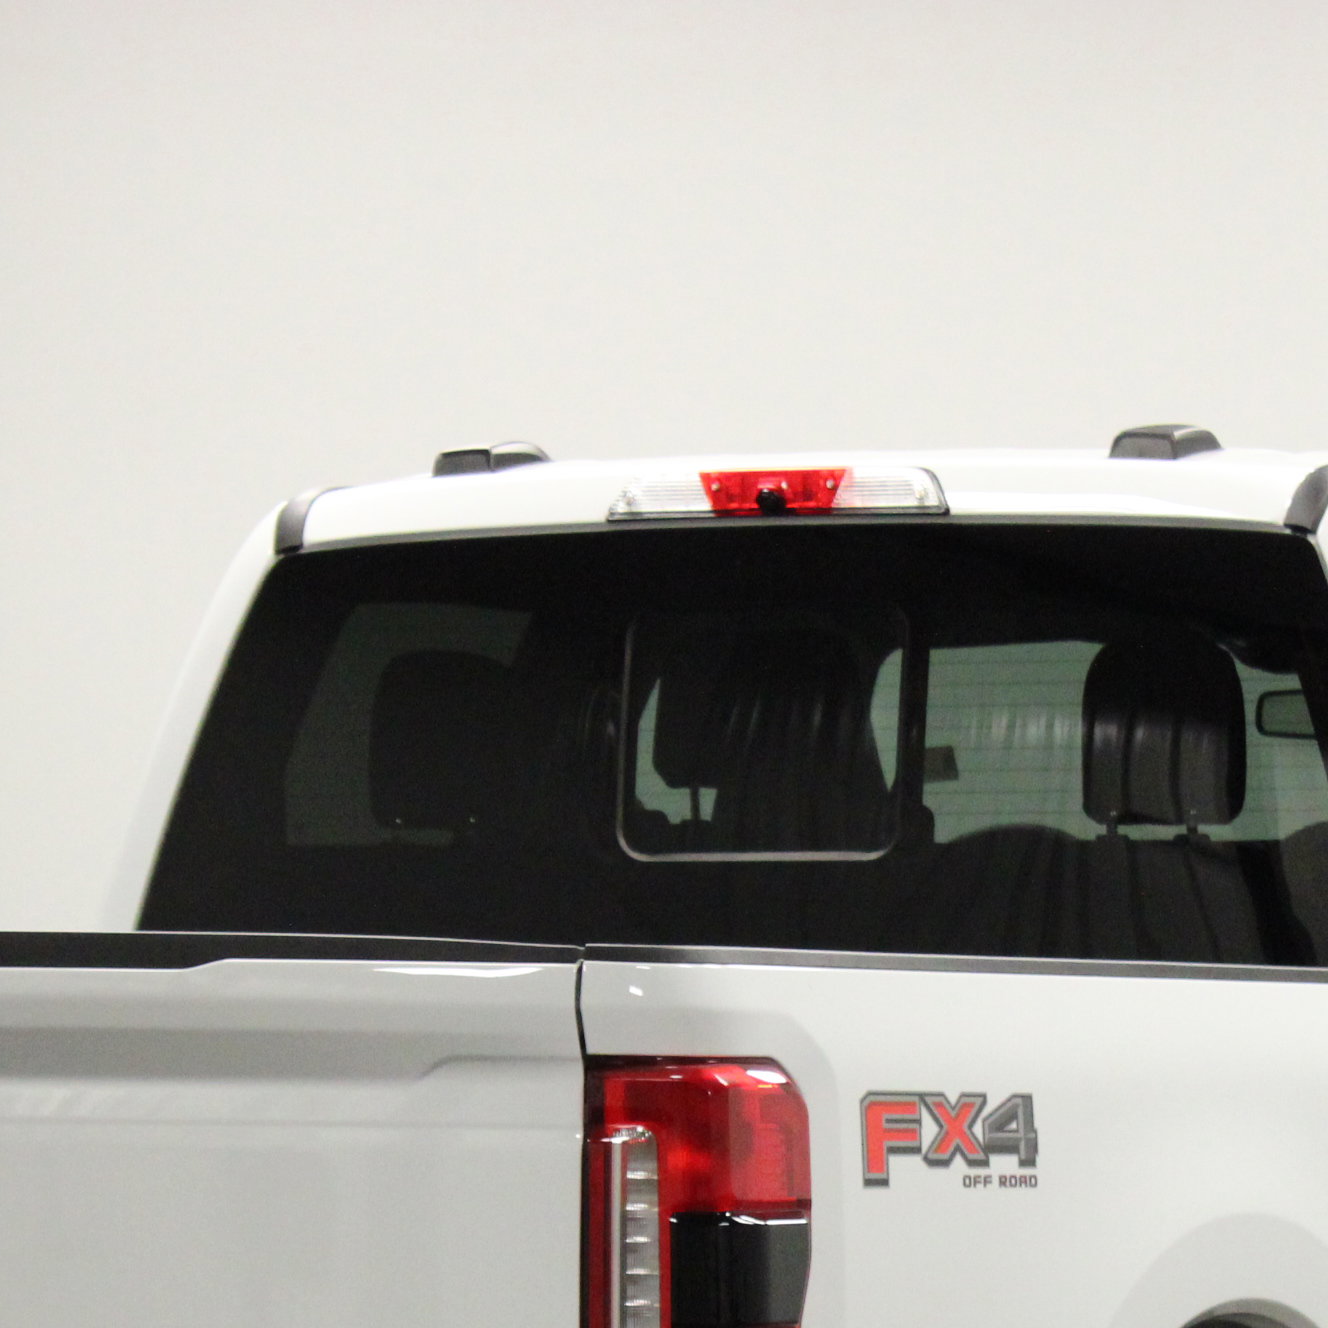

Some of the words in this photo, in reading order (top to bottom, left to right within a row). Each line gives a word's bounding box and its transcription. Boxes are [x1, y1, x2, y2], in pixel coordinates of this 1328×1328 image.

[860, 1091, 1038, 1188] FX4
[962, 1174, 992, 1188] OFF
[998, 1174, 1038, 1188] ROAD
